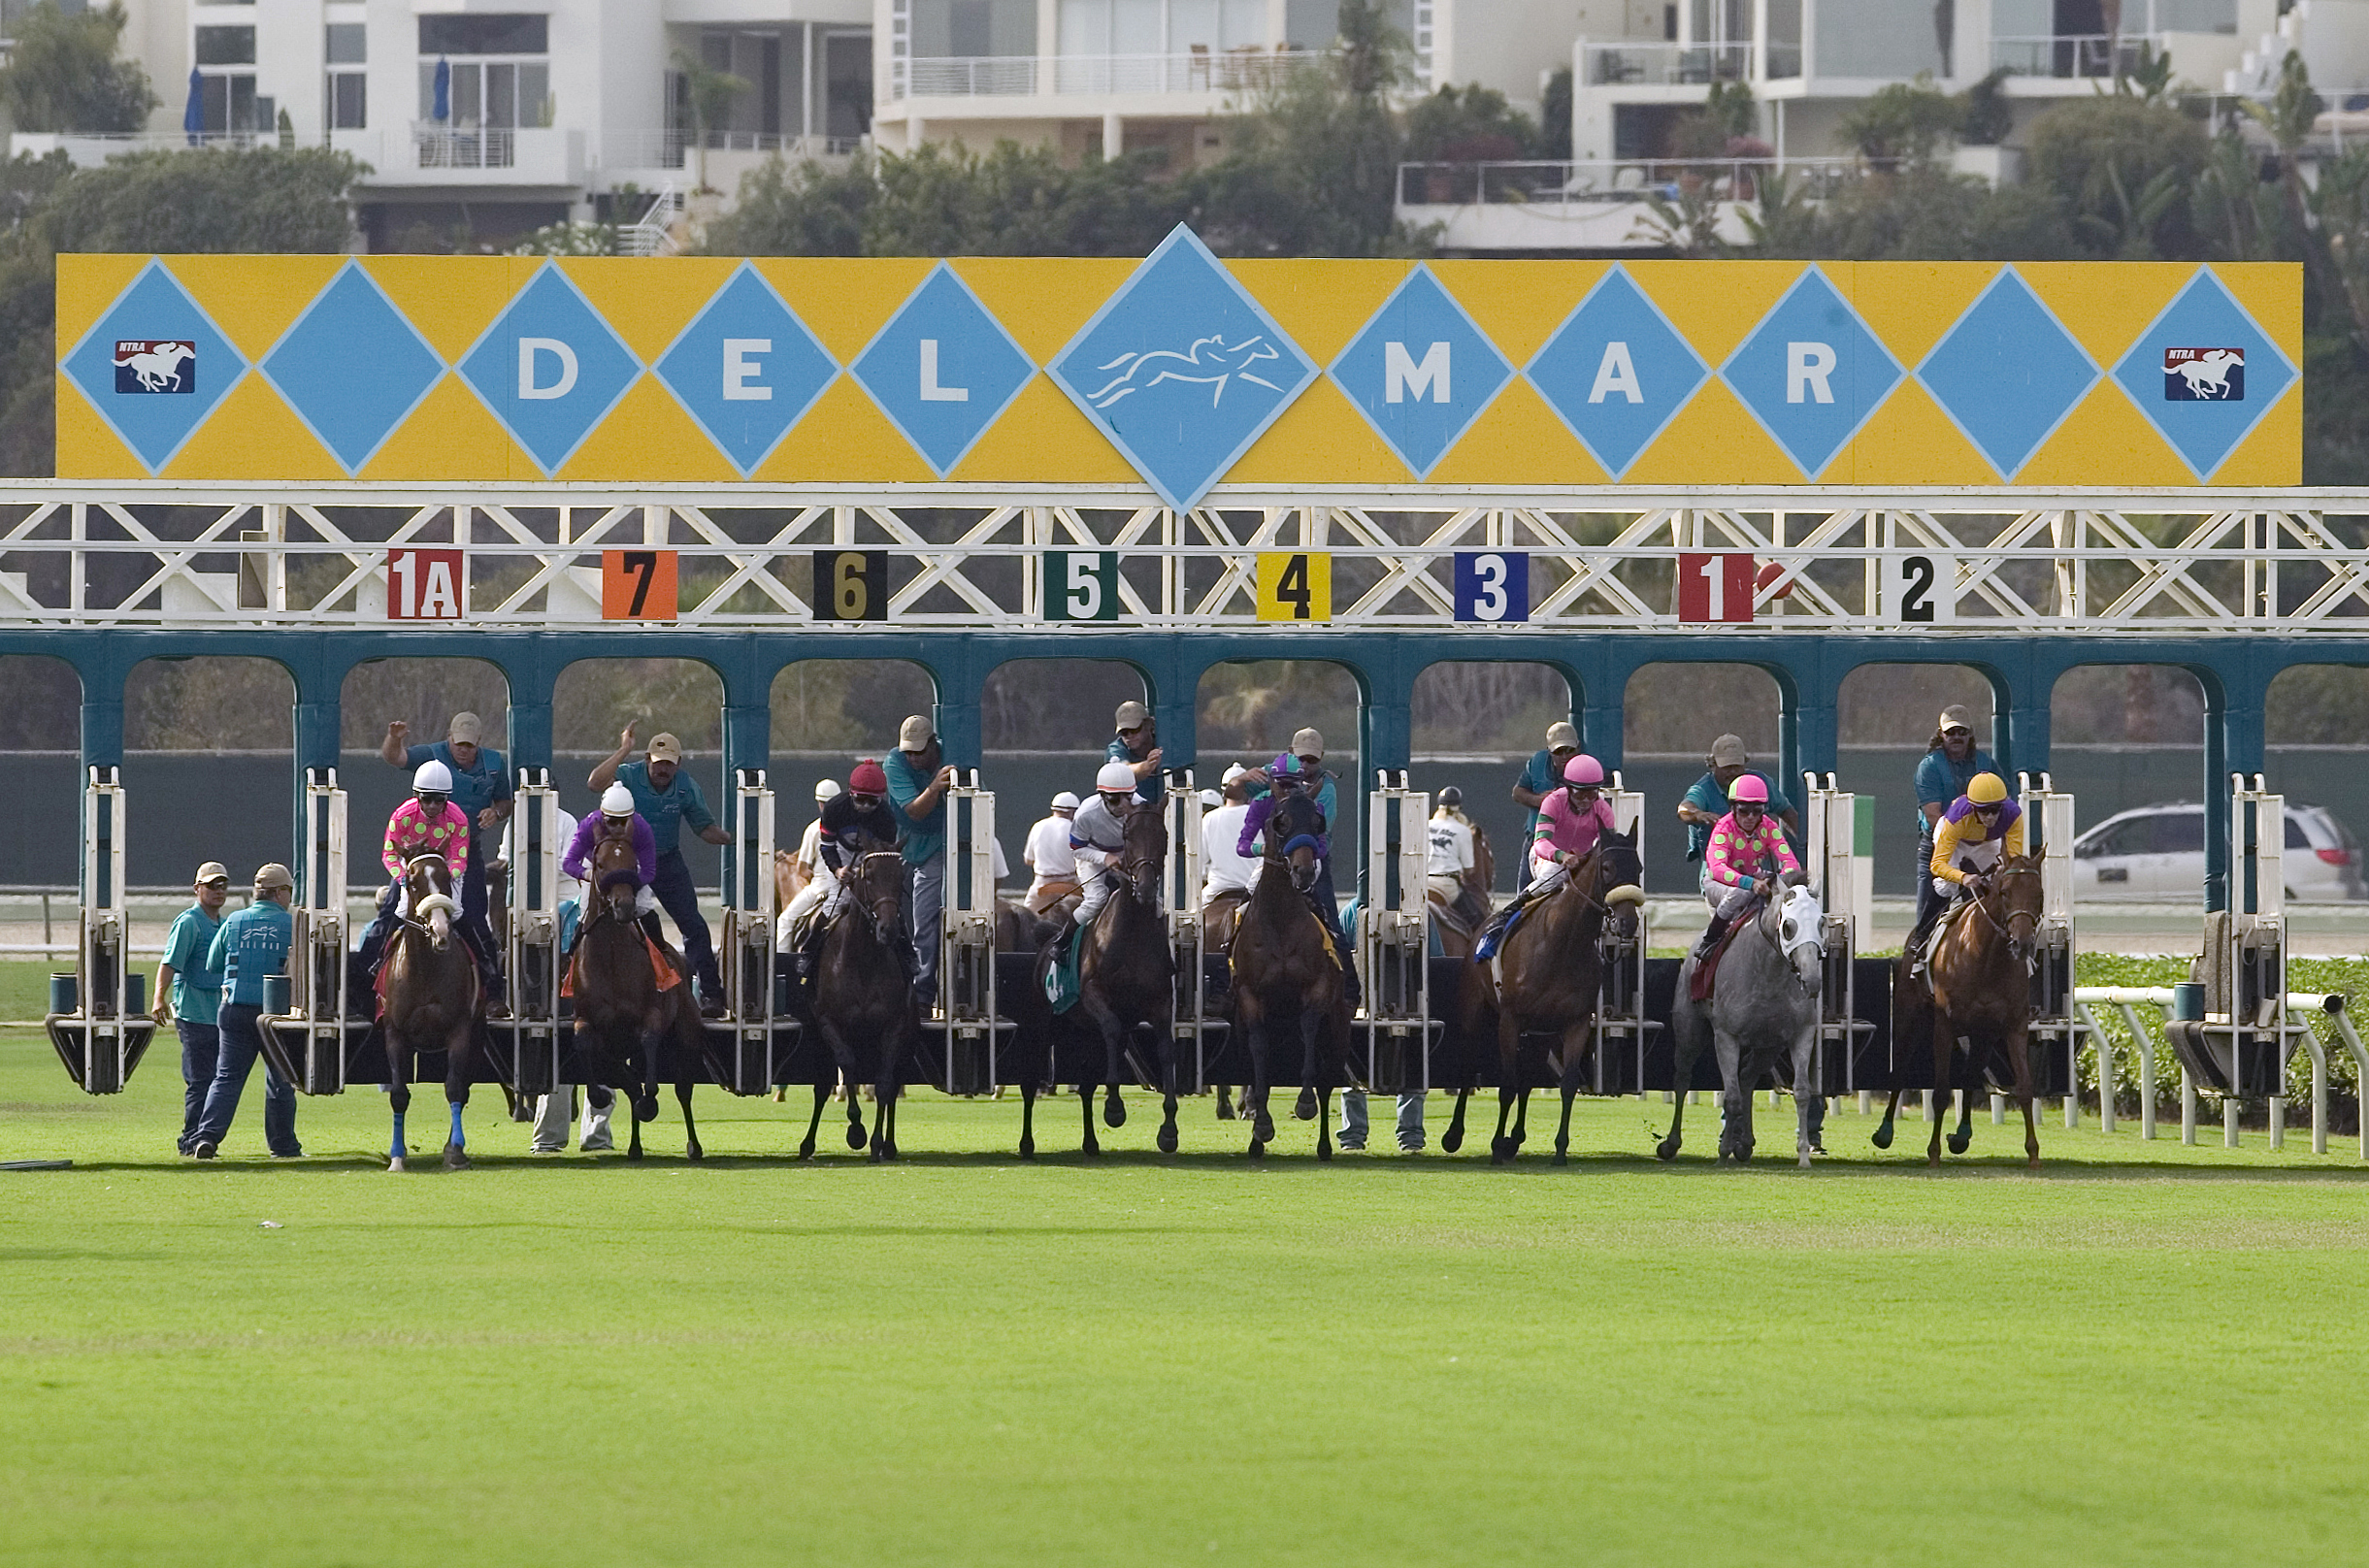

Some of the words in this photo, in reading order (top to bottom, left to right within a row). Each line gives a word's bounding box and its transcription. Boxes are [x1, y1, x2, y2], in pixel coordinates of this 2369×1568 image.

[118, 342, 146, 352] NTRA
[2168, 349, 2195, 360] NTRA
[393, 552, 457, 617] 1A
[624, 554, 657, 617] 7
[835, 553, 867, 618] 6
[1068, 555, 1101, 618] 5
[1277, 557, 1310, 619] 4
[1475, 557, 1507, 619] 3
[1700, 557, 1724, 619] 1
[1901, 557, 1934, 622] 2
